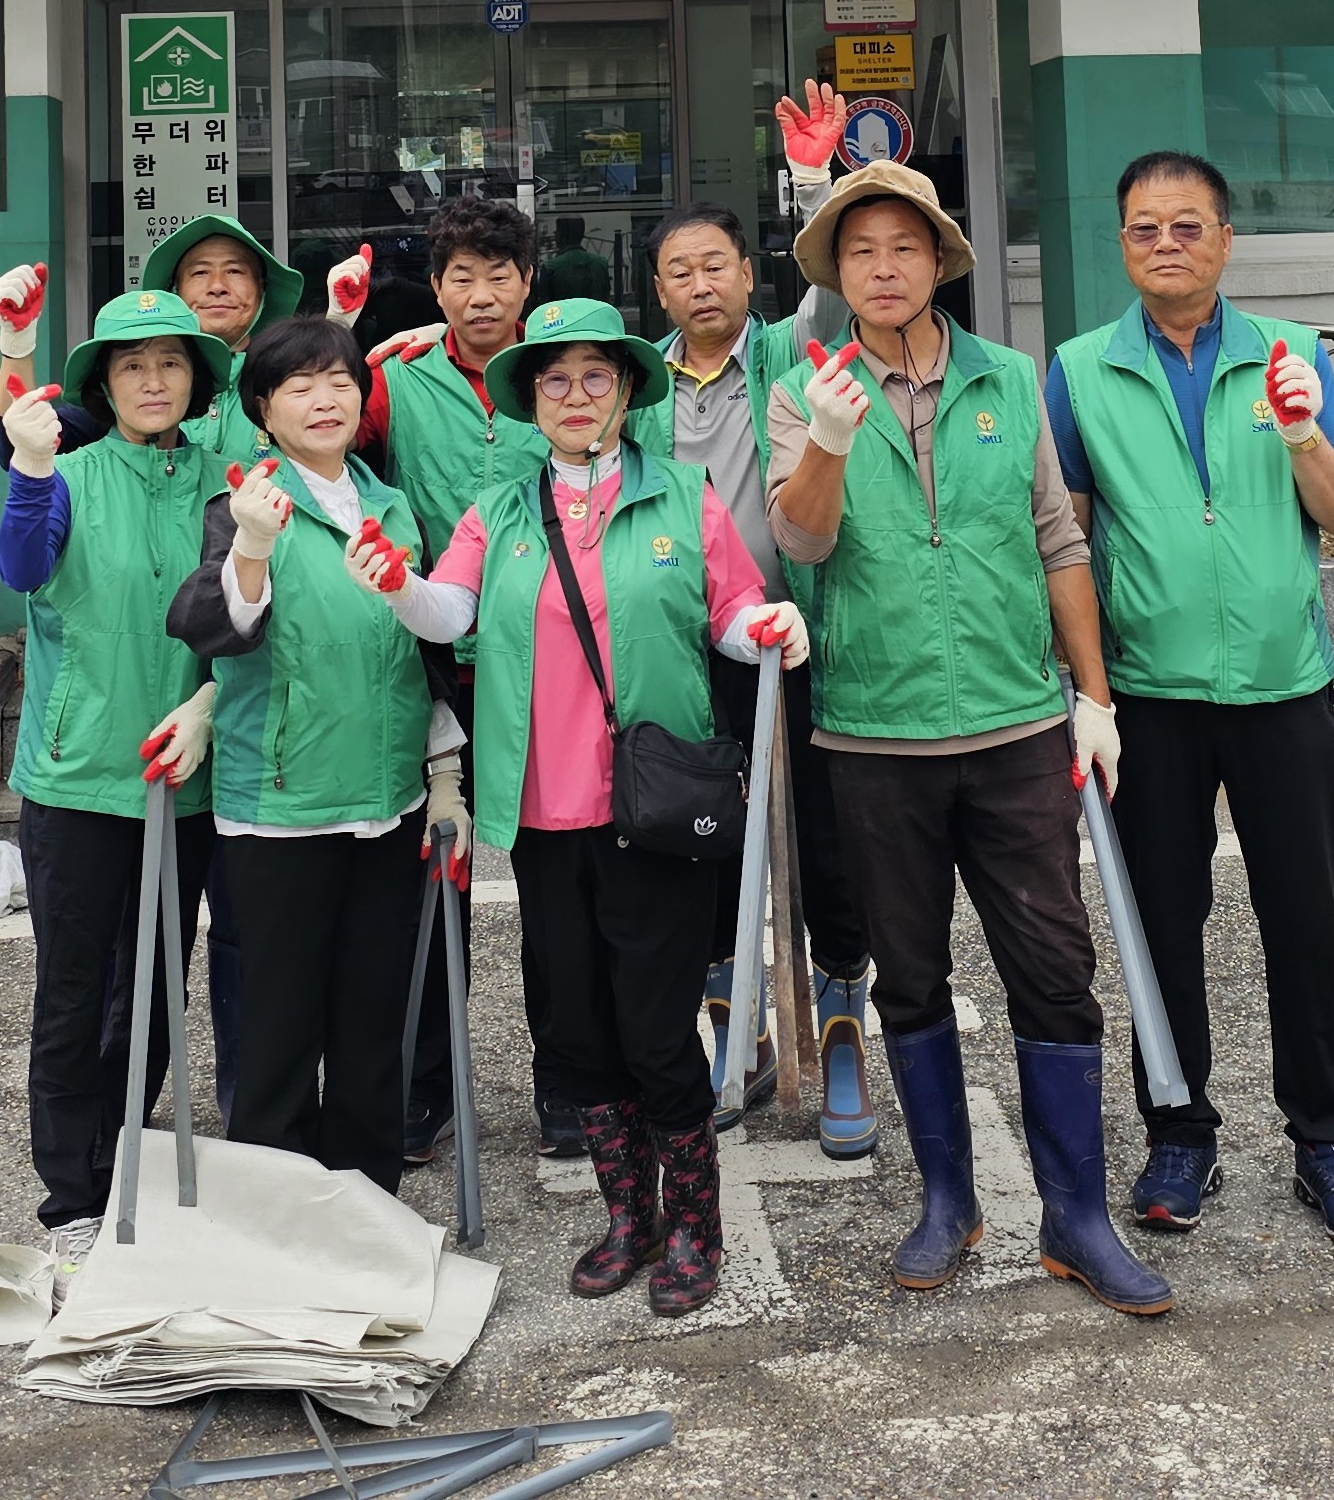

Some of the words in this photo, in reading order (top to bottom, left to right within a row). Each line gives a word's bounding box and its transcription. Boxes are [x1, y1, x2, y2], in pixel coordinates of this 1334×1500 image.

[492, 4, 523, 21] ADT
[853, 41, 896, 55] 대피소
[857, 57, 892, 65] SHELTER
[132, 119, 226, 145] 무더위
[133, 152, 229, 177] 한파
[134, 185, 227, 210] 쉼터
[542, 319, 564, 332] SMU
[977, 434, 1003, 445] SMU
[253, 449, 270, 459] SM
[652, 557, 679, 568] SMU
